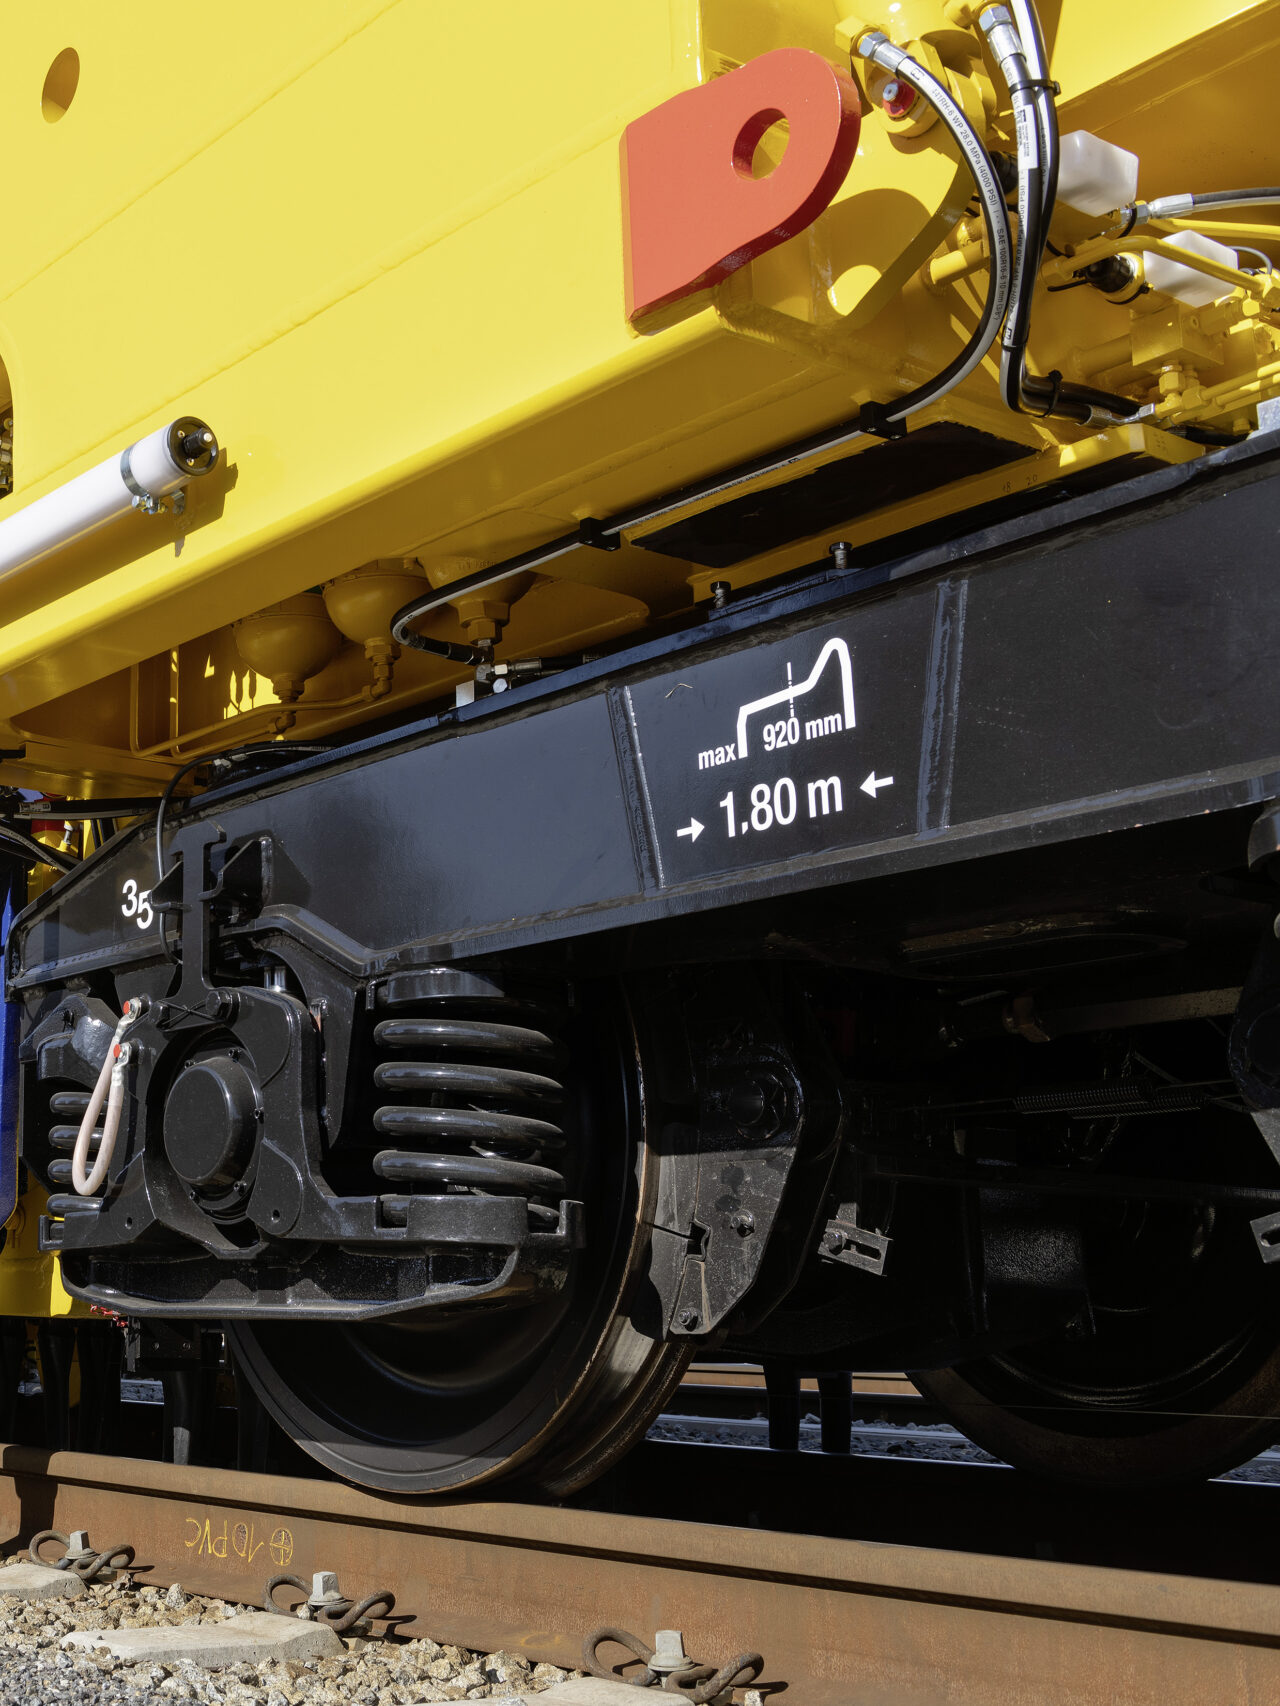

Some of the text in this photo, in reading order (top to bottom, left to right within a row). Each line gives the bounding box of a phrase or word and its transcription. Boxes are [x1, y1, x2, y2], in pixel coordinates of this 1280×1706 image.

[952, 115, 964, 132] WP
[969, 144, 982, 166] MPa
[978, 165, 992, 188] (4000
[987, 185, 999, 206] PSI)
[996, 228, 1006, 245] SAE
[999, 280, 1006, 290] 10
[698, 713, 843, 770] max 920 mm
[719, 775, 843, 838] 1,80 m
[121, 878, 154, 930] 35
